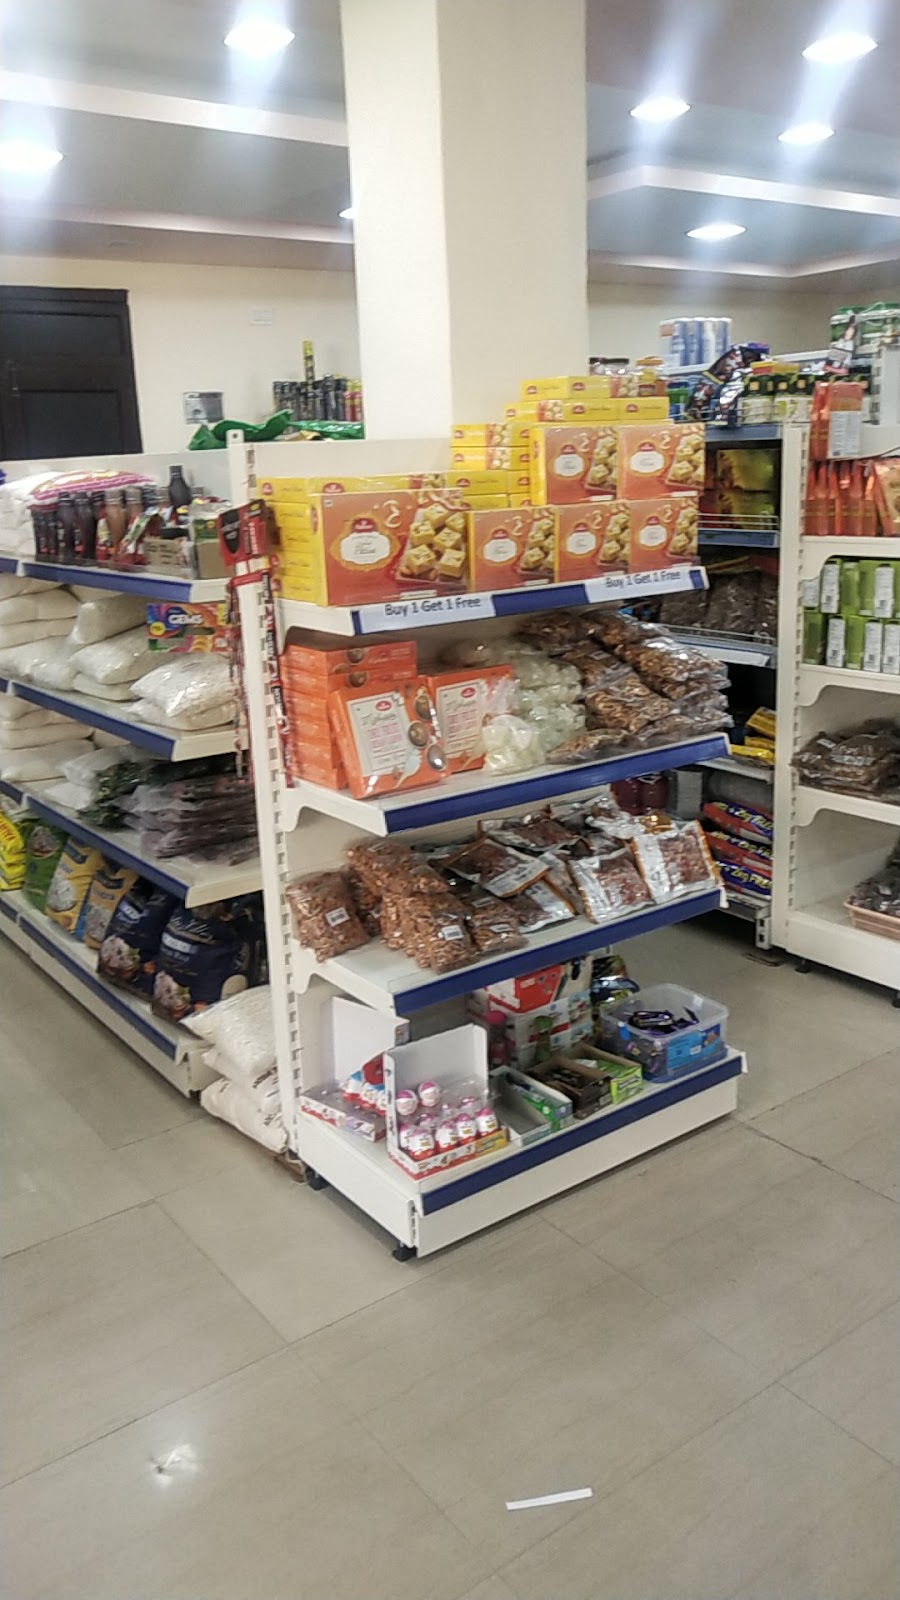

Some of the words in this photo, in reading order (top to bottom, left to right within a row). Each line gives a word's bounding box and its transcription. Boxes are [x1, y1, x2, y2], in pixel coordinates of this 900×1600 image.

[605, 577, 624, 589] Buy
[626, 575, 633, 586] 1
[633, 573, 651, 584] Get
[653, 572, 659, 582] 1
[660, 570, 681, 580] Free
[384, 604, 408, 617] Buy
[412, 602, 419, 614] 1
[420, 600, 443, 612] Get
[447, 599, 453, 610] 1
[454, 597, 482, 609] Free
[168, 614, 203, 625] GEMS
